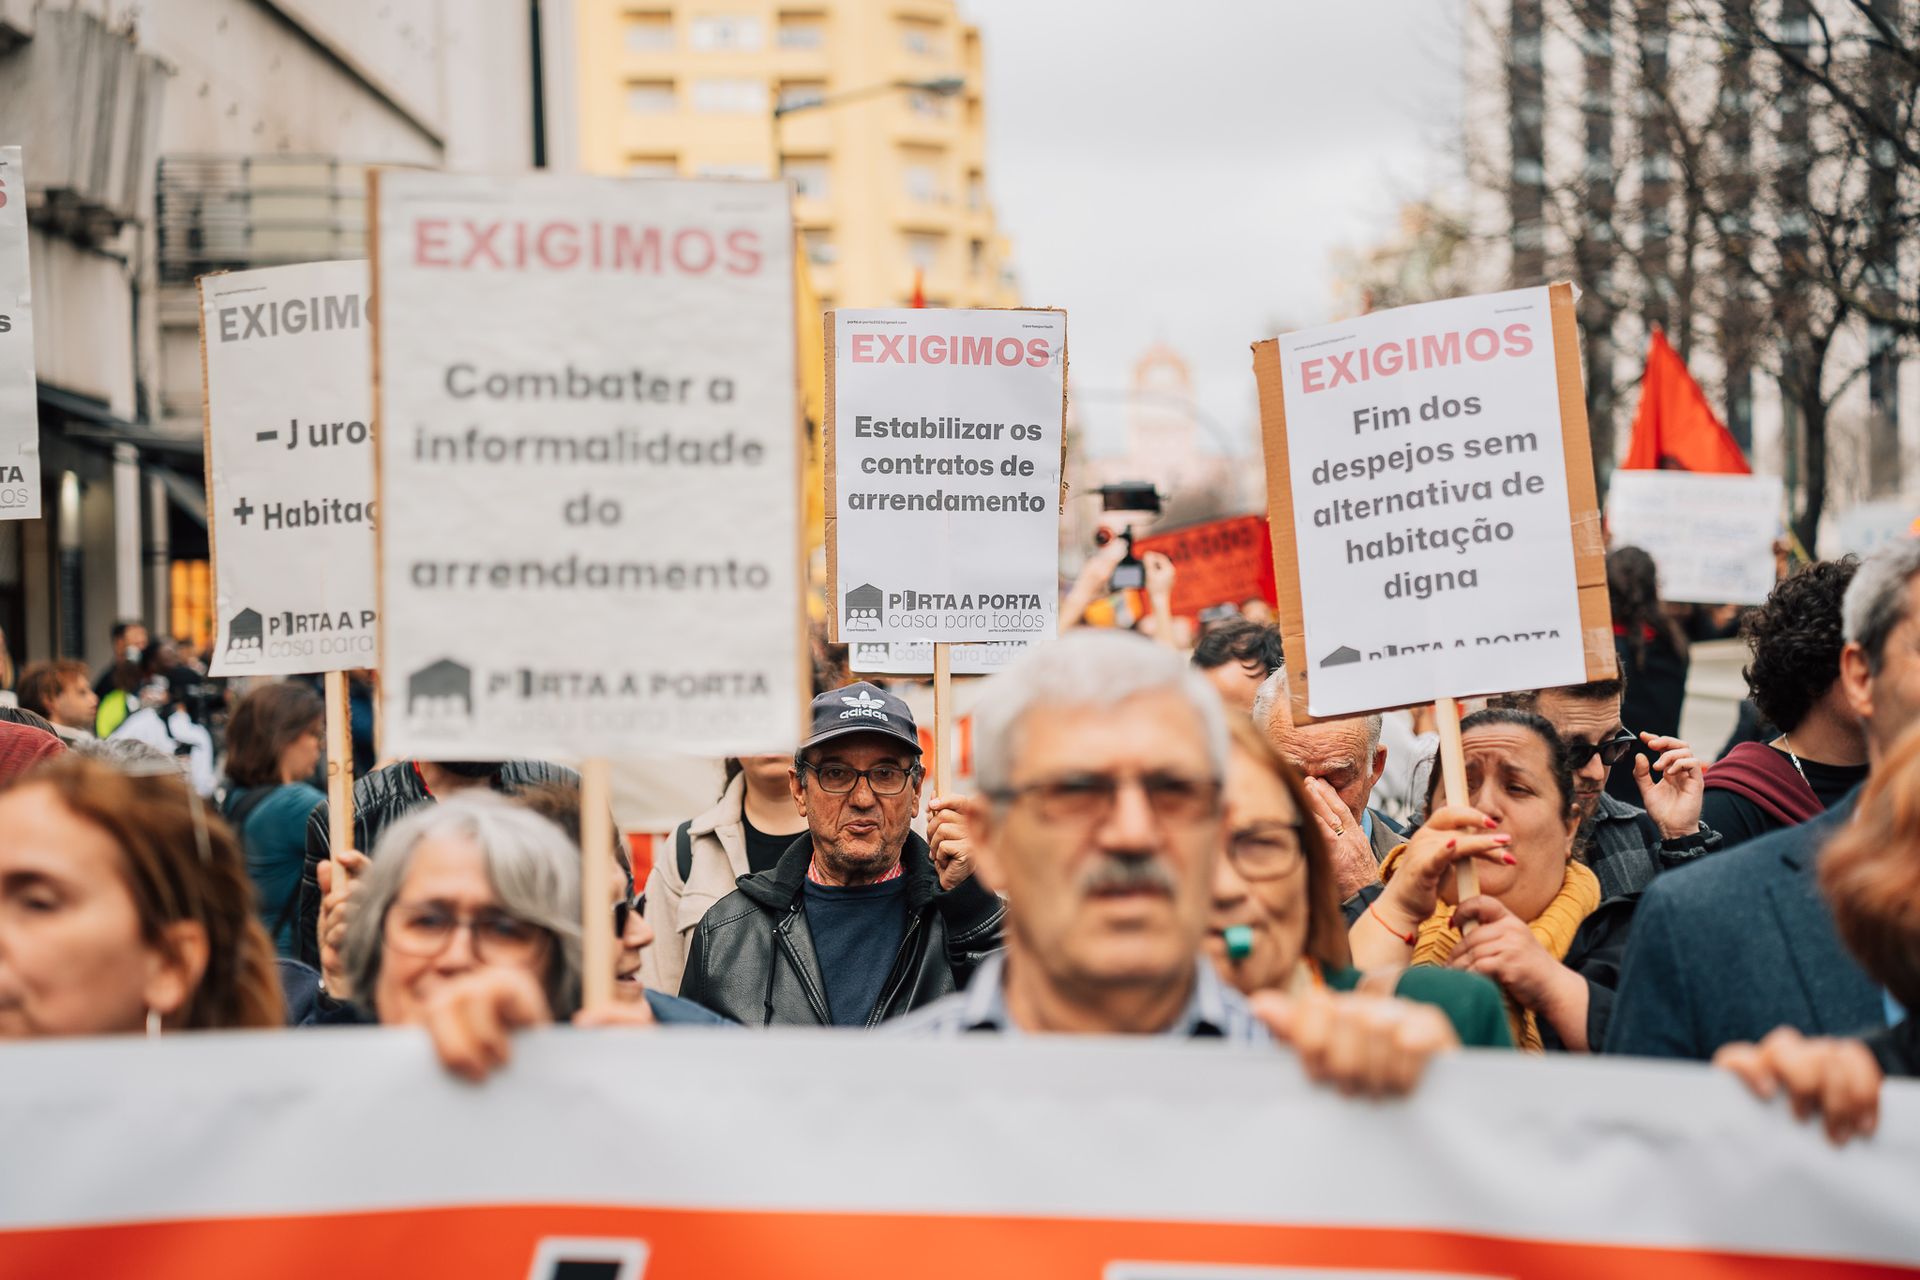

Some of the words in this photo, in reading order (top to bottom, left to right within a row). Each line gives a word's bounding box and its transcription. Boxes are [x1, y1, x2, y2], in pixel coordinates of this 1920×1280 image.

[413, 218, 764, 276] EXIGIMOS
[852, 334, 1050, 367] EXIGIMOS
[1300, 323, 1533, 394] EXIGIMOS
[444, 363, 693, 404] Combater
[707, 376, 736, 404] a
[855, 415, 1004, 440] Estabilizar
[1010, 423, 1042, 442] os
[1353, 405, 1411, 435] Fim
[1419, 396, 1481, 422] dos
[413, 426, 764, 466] informalidade
[1312, 443, 1455, 485] despejos
[1463, 432, 1538, 459] sem
[860, 453, 994, 476] contratos
[1000, 454, 1035, 477] de
[562, 492, 623, 527] do
[847, 489, 1046, 513] arrendamento
[1313, 480, 1492, 527] alternativa
[1501, 470, 1545, 497] de
[1345, 517, 1513, 564] habitação
[408, 553, 770, 590] arrendamento
[1384, 568, 1478, 600] digna
[960, 594, 974, 610] A
[978, 594, 1042, 610] PORTA
[338, 612, 353, 630] A
[888, 614, 938, 629] casa
[944, 614, 986, 629] para
[992, 611, 1044, 629] todos
[618, 673, 639, 696] A
[649, 671, 770, 699] PORTA
[839, 708, 889, 722] adidas
